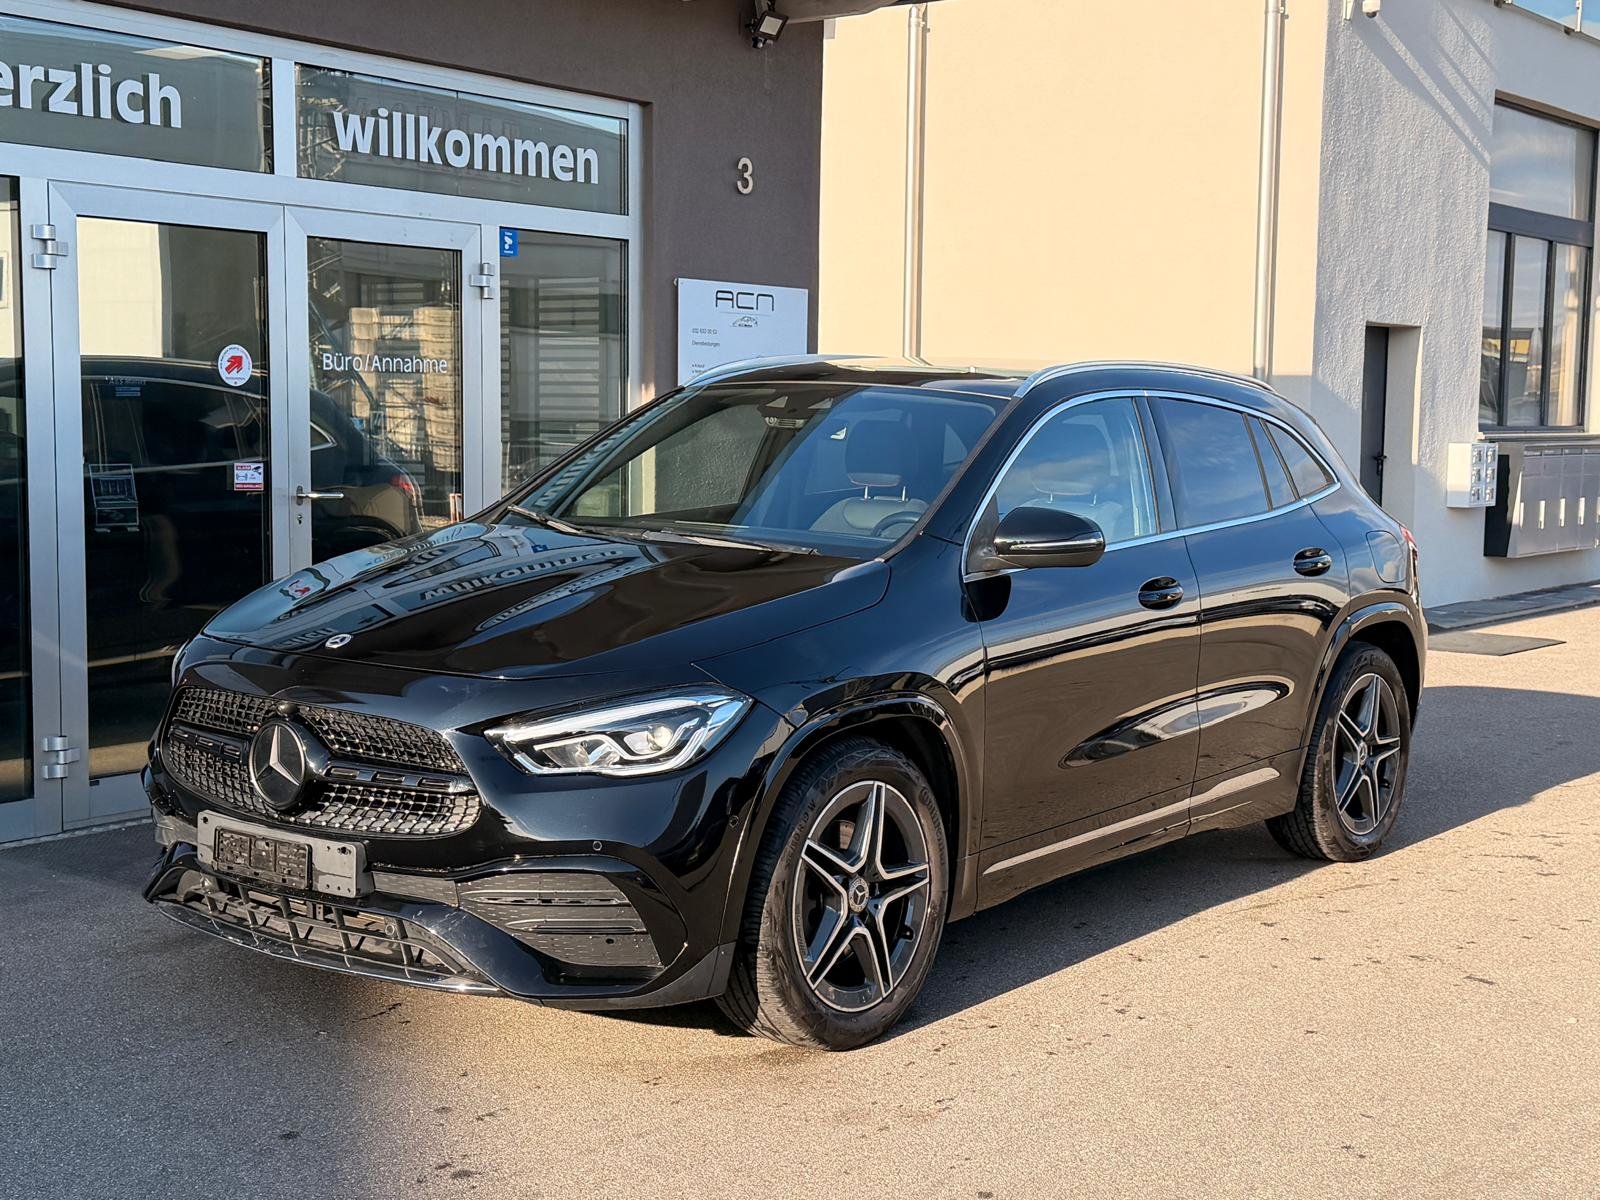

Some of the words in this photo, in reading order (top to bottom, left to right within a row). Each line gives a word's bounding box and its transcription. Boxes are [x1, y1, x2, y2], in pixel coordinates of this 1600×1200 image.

[332, 107, 599, 185] willkommen
[737, 157, 754, 195] 3
[322, 352, 448, 374] Büro/Annahme
